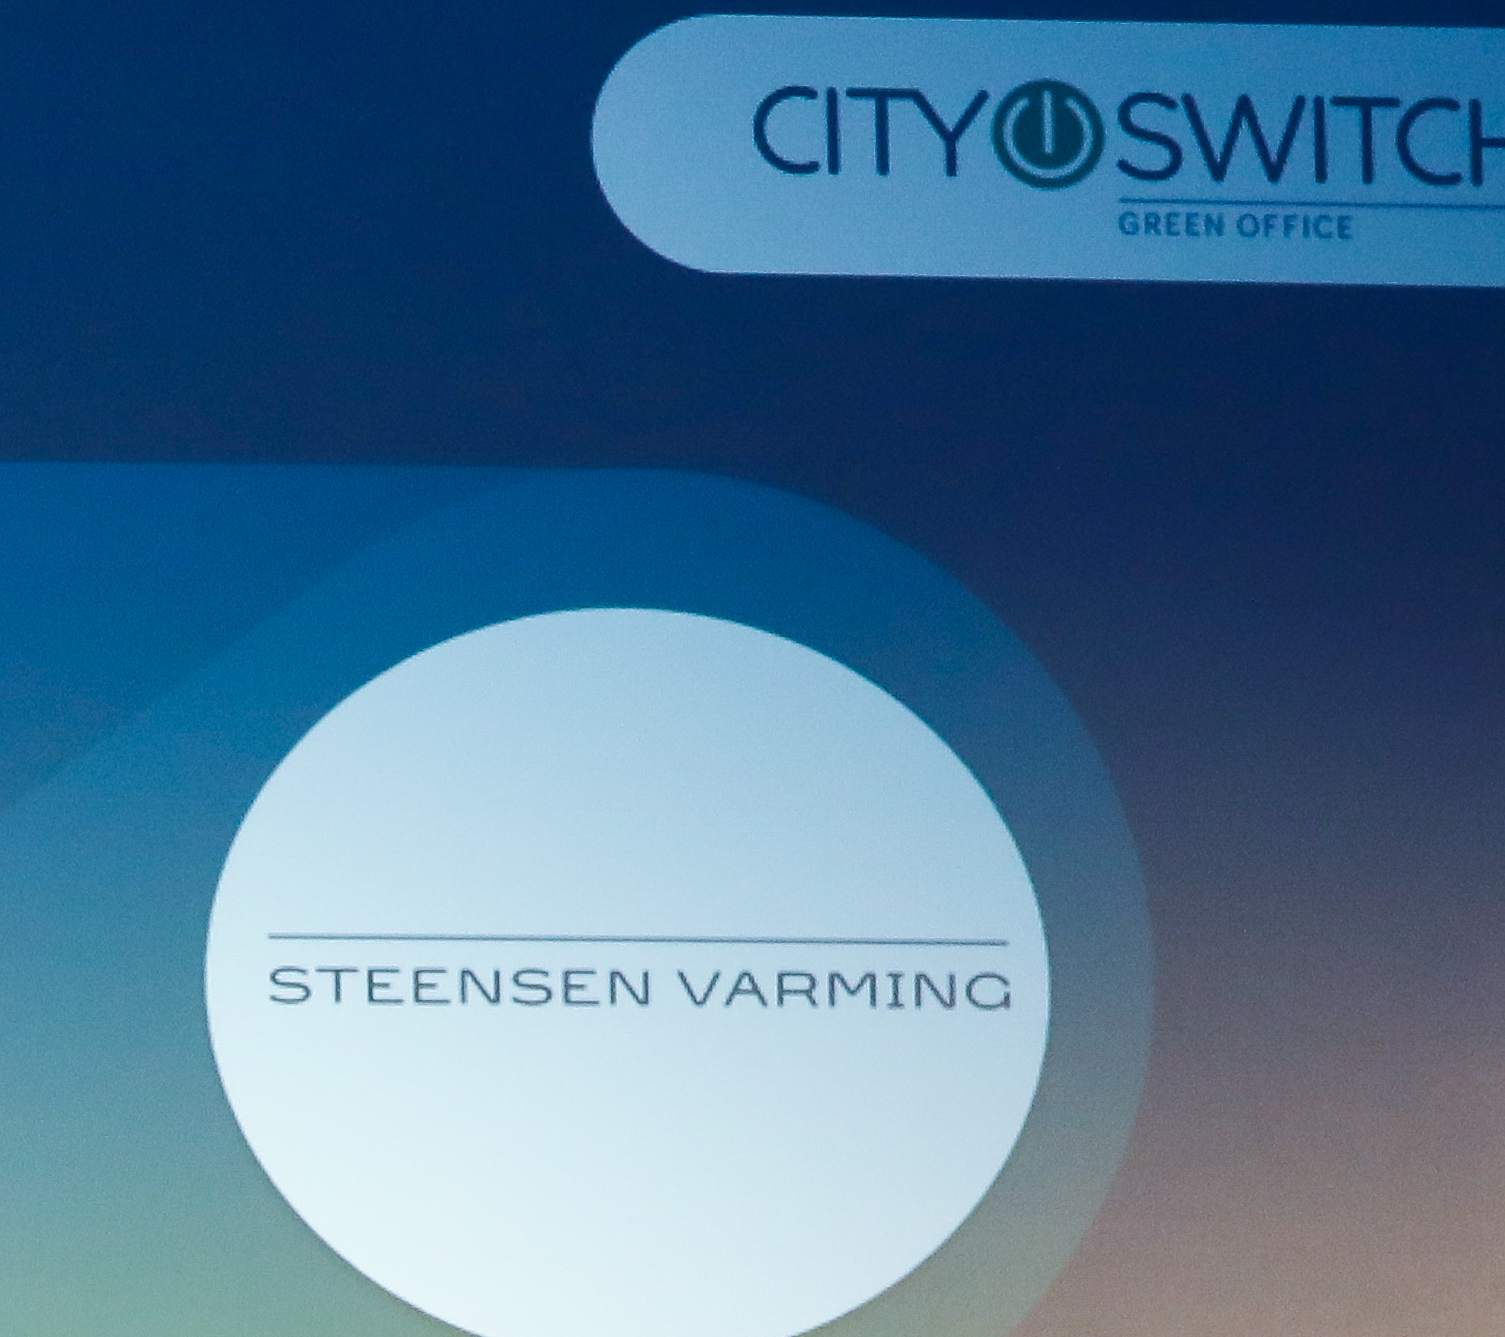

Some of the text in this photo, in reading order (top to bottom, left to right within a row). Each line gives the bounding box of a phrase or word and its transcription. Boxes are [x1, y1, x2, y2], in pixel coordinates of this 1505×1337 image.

[753, 85, 988, 178] CITY
[1118, 211, 1354, 241] GREEN OFFICE
[269, 966, 1012, 1011] STEENSEN VARMING
